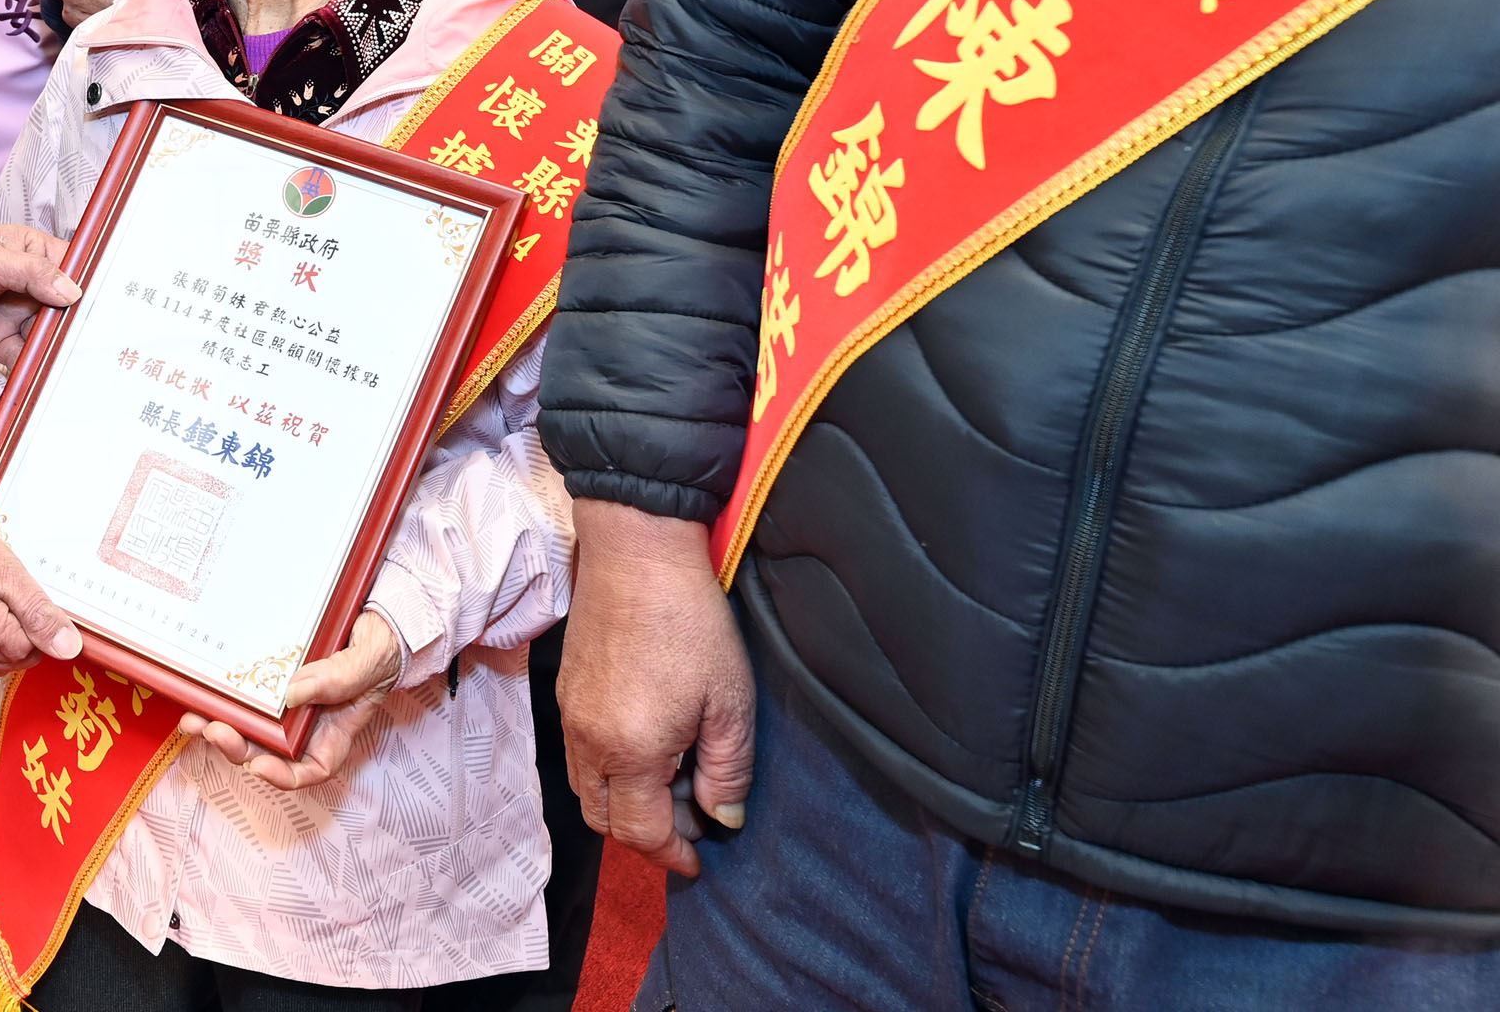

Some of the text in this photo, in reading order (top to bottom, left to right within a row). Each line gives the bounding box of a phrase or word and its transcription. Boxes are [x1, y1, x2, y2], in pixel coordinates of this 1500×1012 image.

[243, 210, 341, 261] 苗栗縣政府
[200, 339, 270, 377] 績優志工
[20, 664, 154, 846] 菊妹
